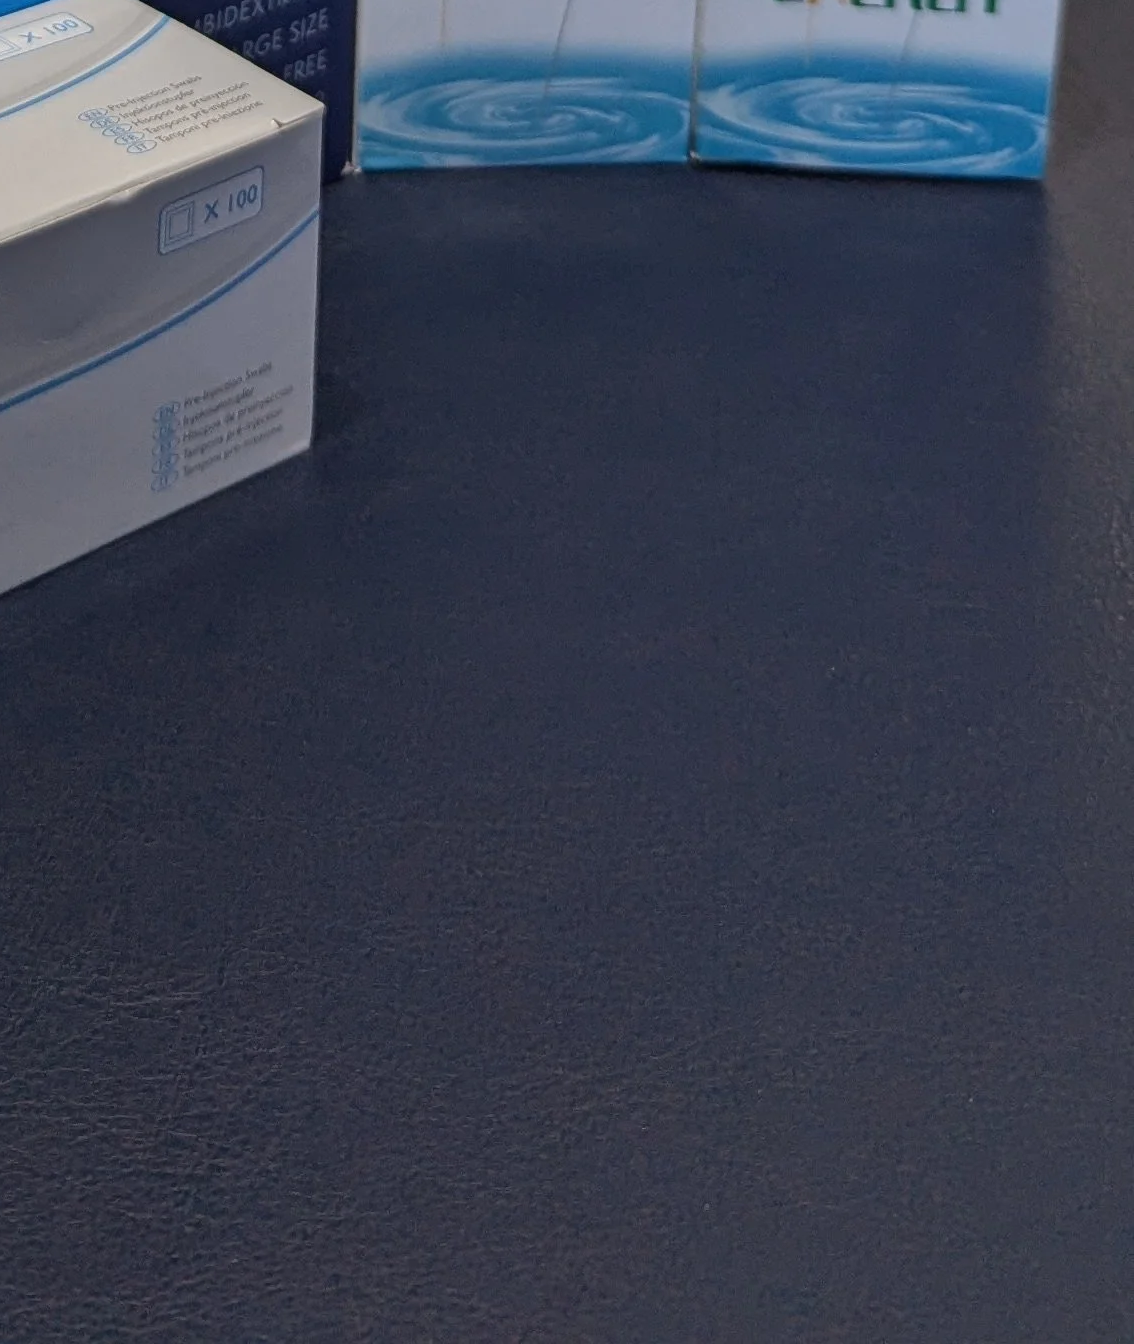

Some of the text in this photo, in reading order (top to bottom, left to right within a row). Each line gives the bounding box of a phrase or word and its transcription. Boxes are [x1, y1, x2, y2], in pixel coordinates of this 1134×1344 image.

[46, 19, 80, 38] 100
[242, 7, 329, 59] RGE SIZE
[227, 183, 259, 215] 100
